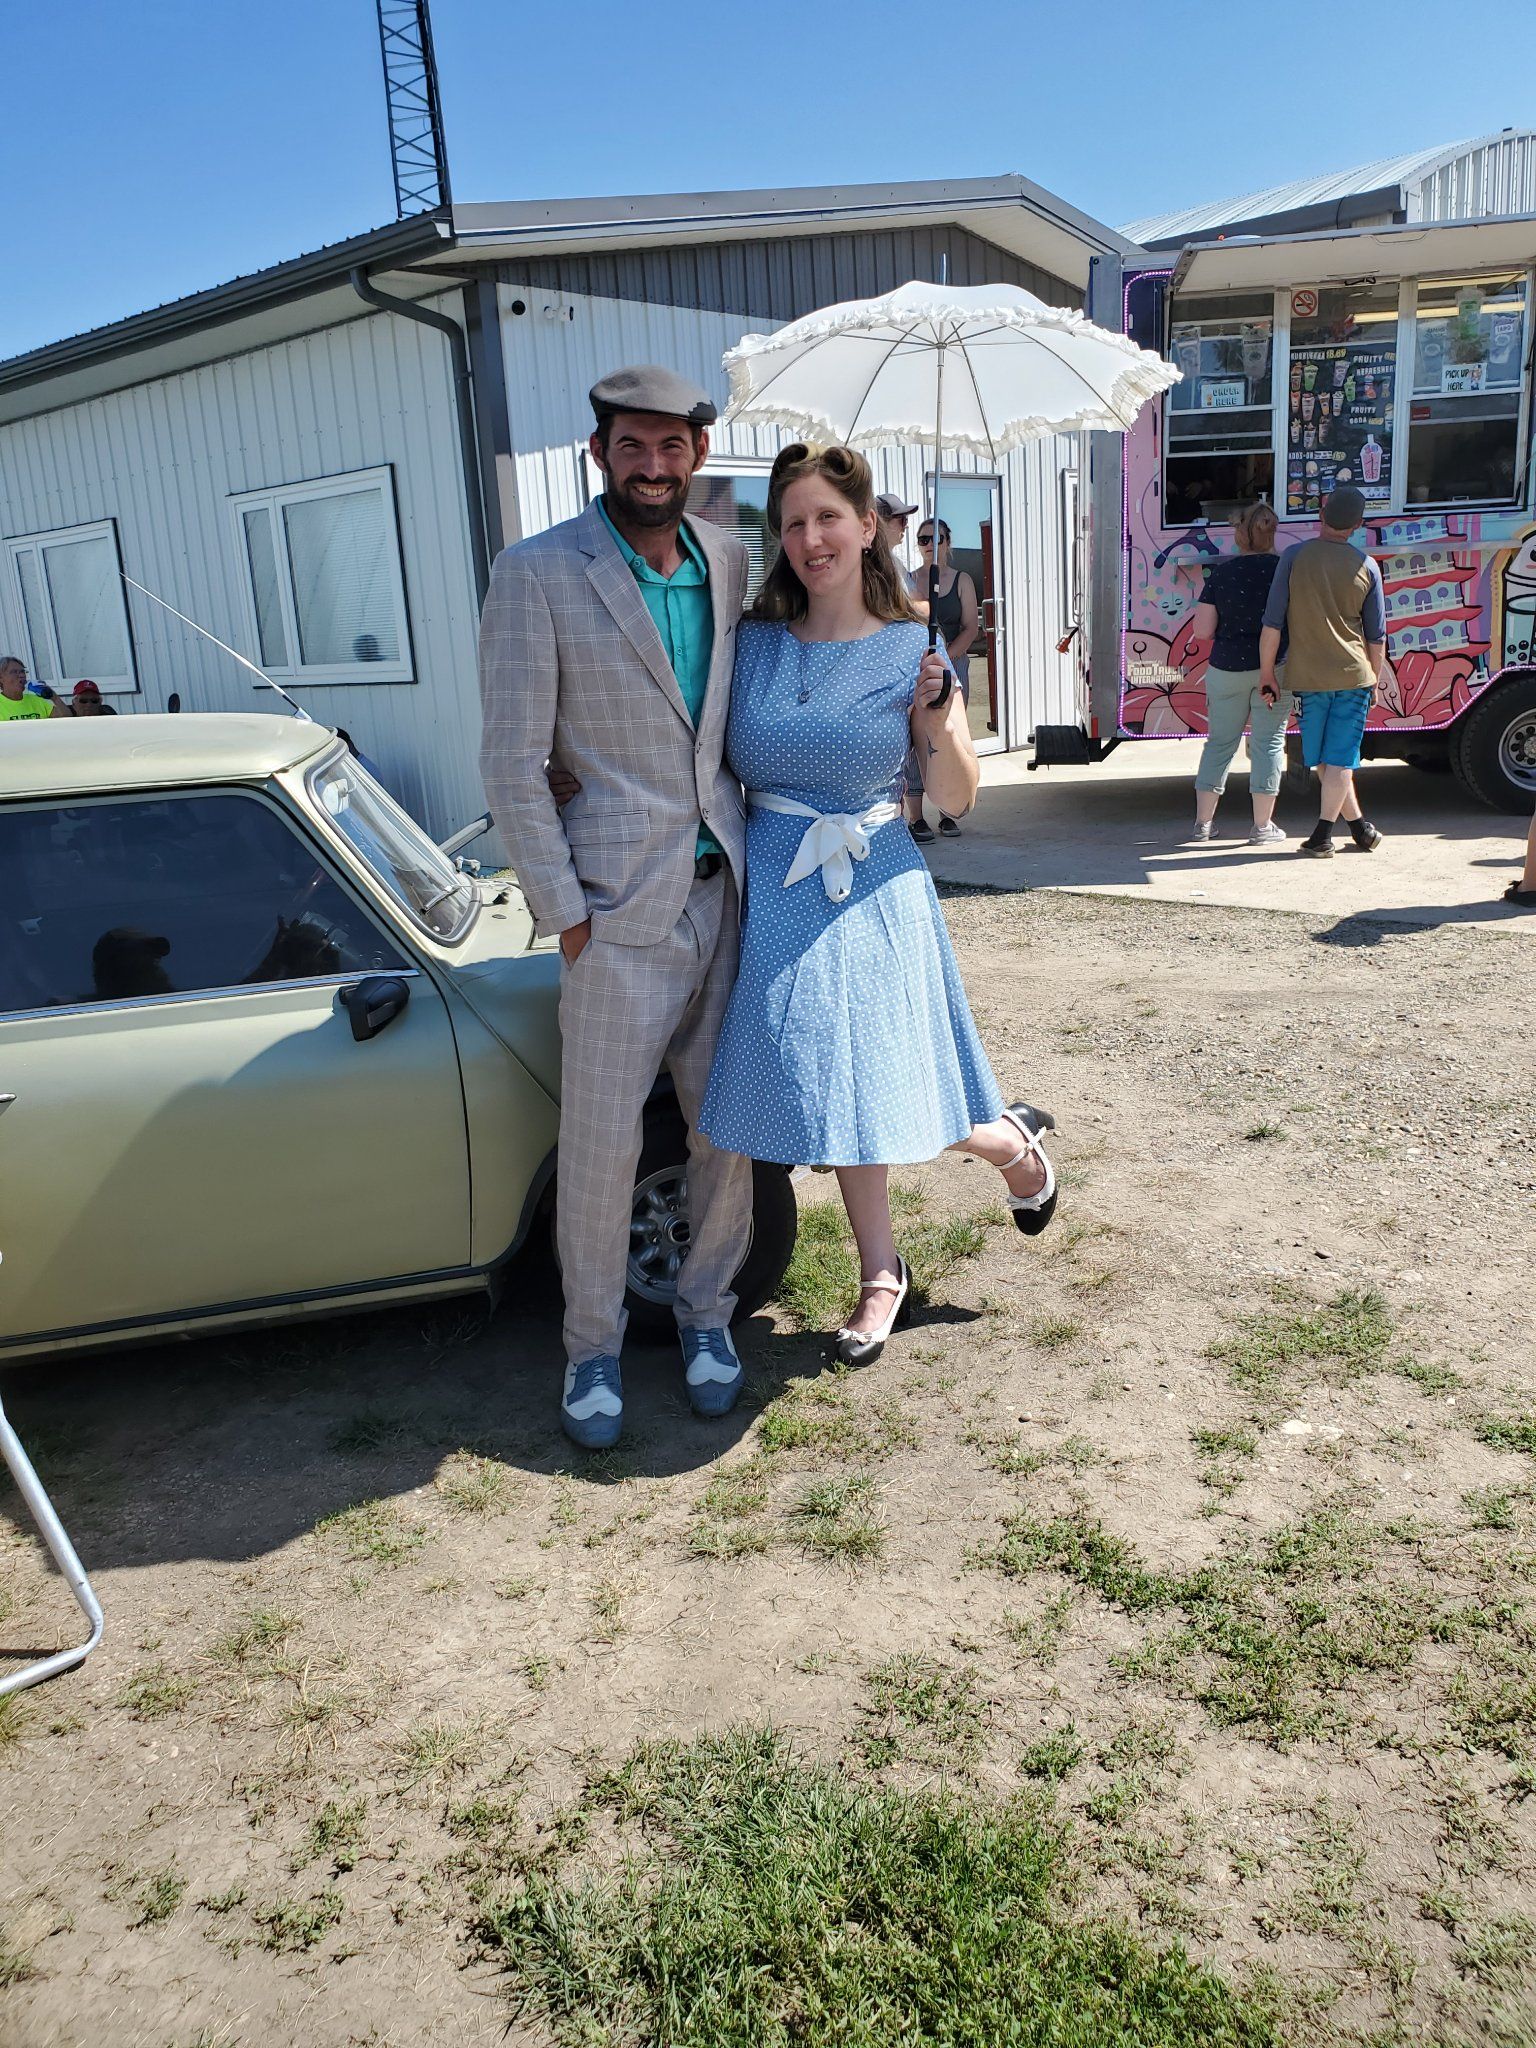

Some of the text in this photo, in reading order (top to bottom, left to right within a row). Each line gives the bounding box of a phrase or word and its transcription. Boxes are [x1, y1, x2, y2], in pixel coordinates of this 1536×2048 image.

[1353, 355, 1383, 363] FRUITY
[1445, 369, 1469, 379] PICK UP
[1447, 381, 1464, 391] HERE
[1216, 398, 1237, 406] HERE
[1350, 406, 1376, 414] FRUITY
